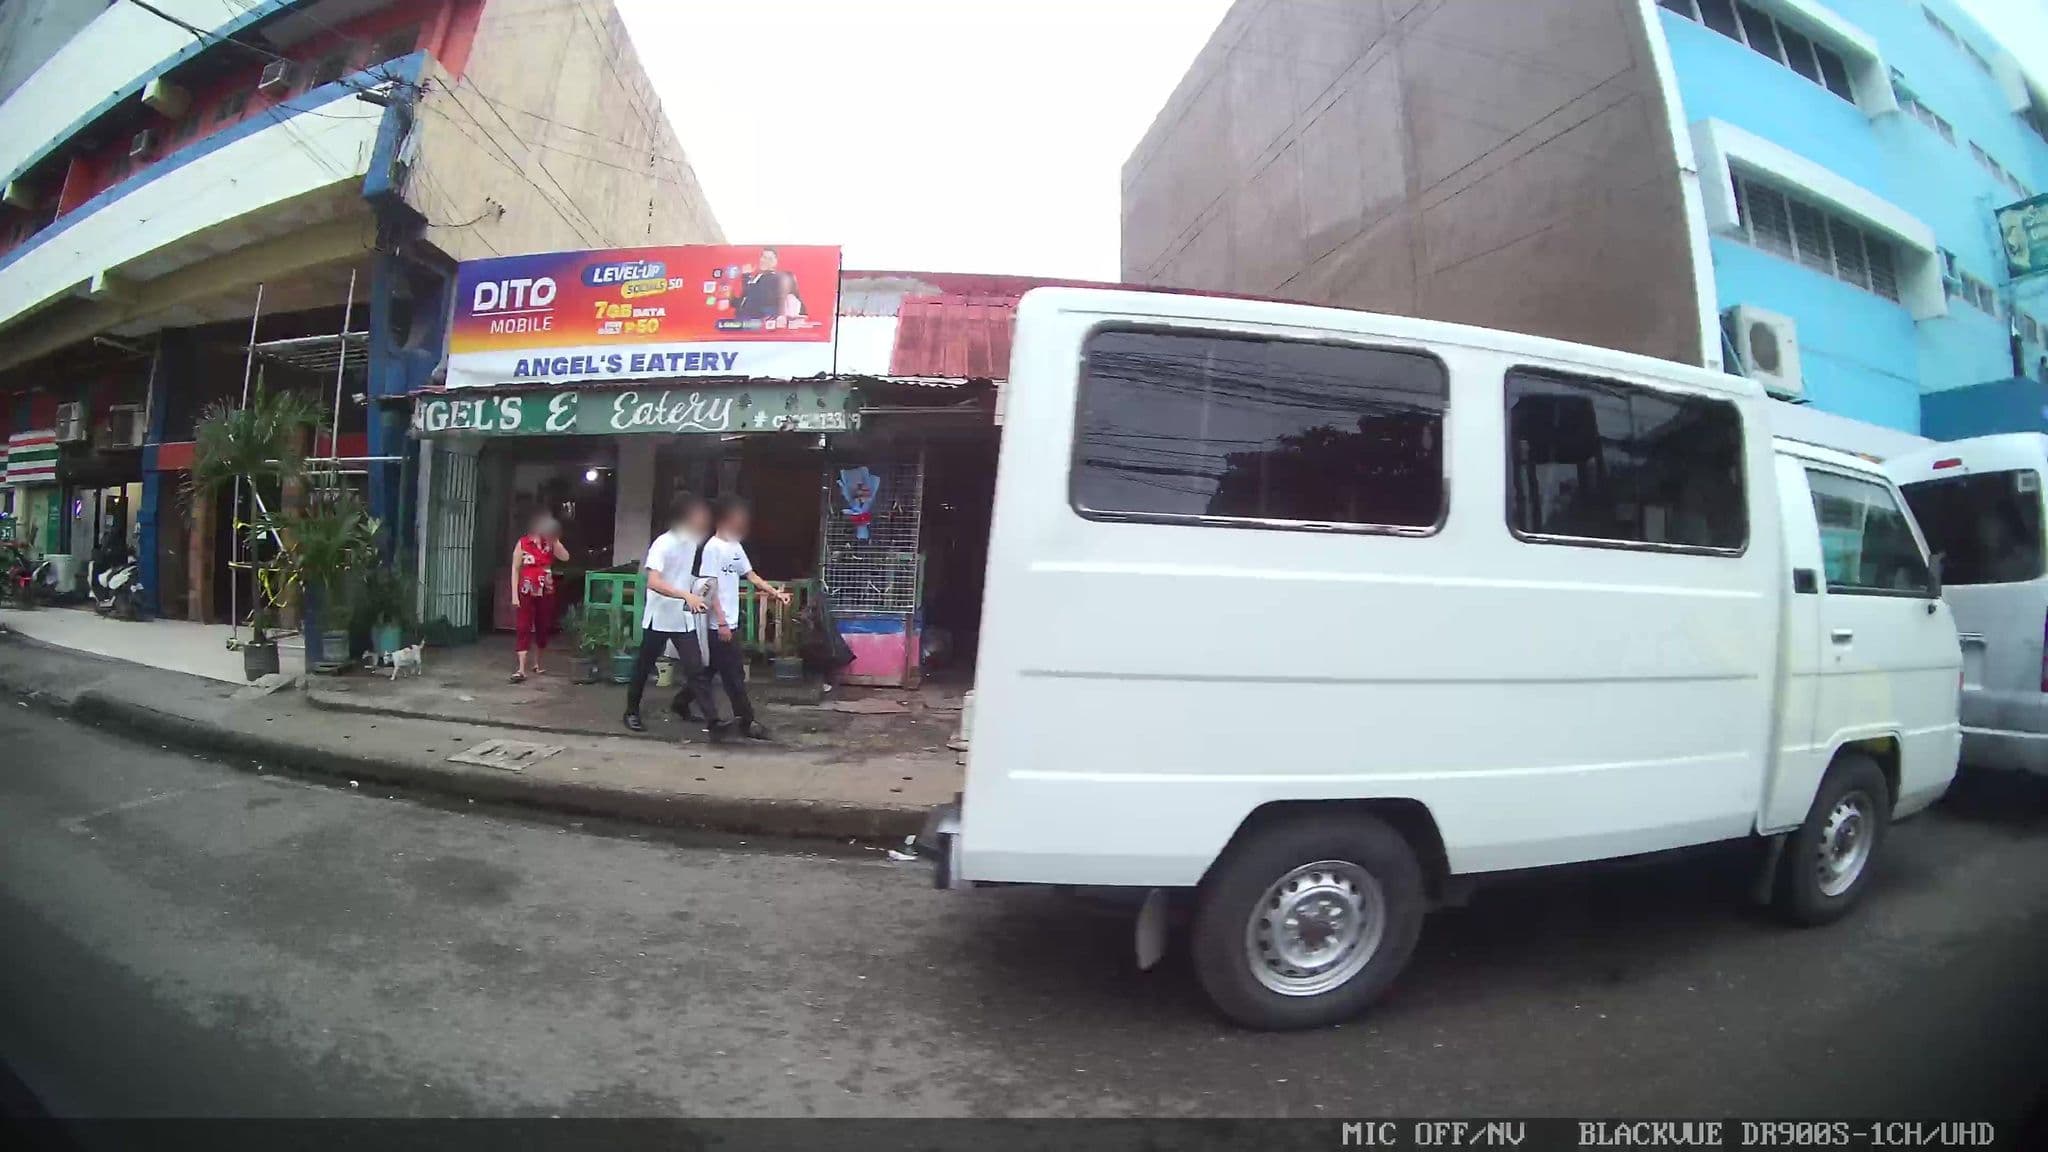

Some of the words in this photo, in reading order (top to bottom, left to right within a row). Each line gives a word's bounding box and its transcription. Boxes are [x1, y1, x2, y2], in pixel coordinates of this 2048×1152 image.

[472, 277, 557, 311] DITO
[489, 316, 554, 334] MOBILE
[513, 354, 623, 377] ANGEL'S
[629, 352, 739, 373] EATERY
[610, 390, 733, 431] Eatery
